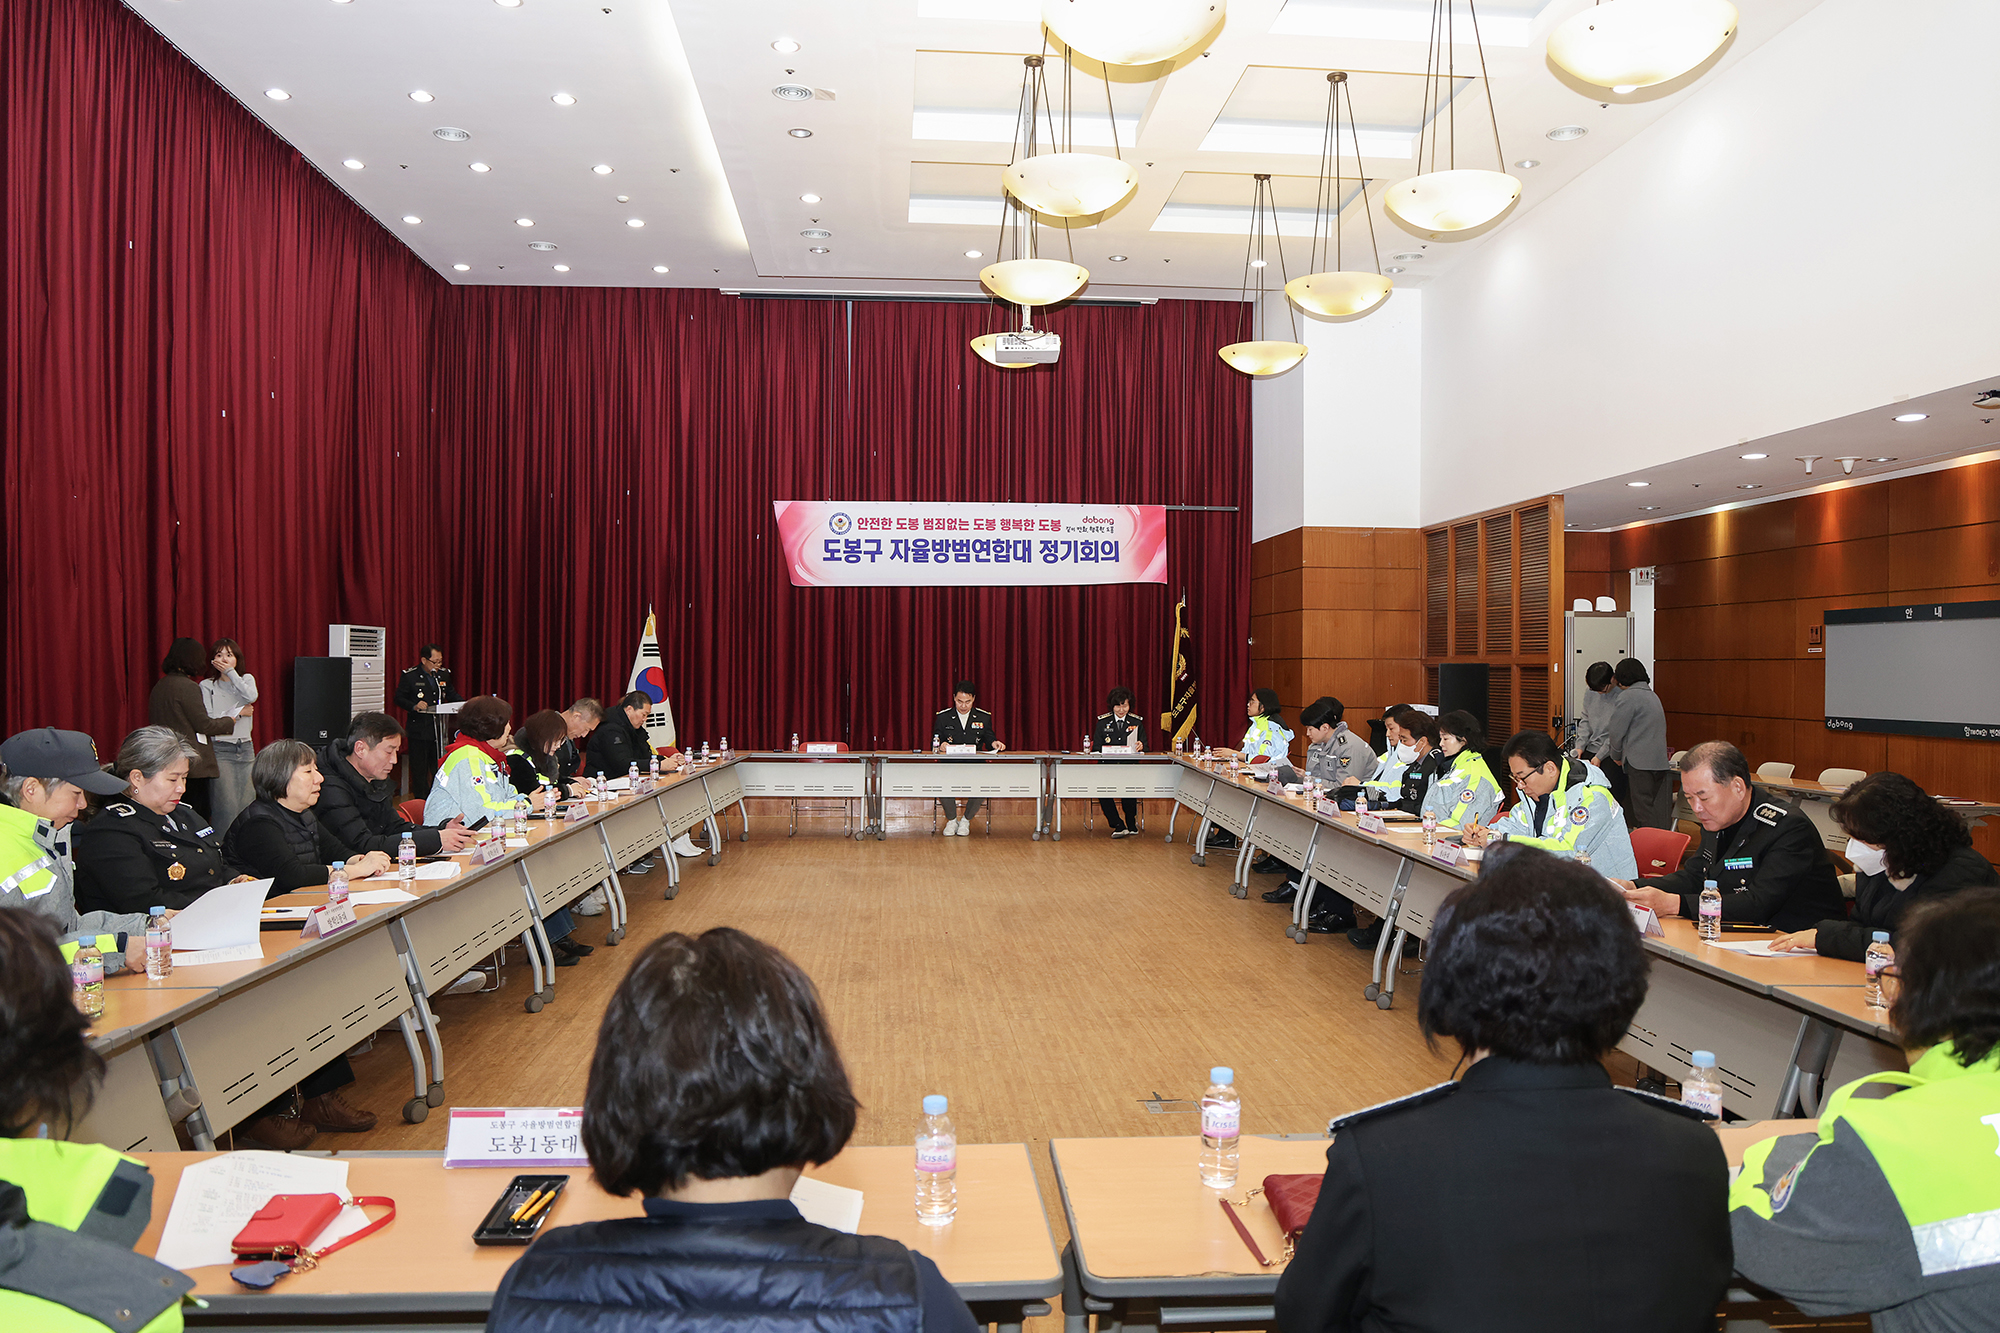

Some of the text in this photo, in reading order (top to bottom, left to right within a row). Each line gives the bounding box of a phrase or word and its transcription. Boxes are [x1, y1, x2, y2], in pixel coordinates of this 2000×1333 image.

[857, 517, 893, 531] 안전한
[896, 517, 920, 531] 도봉
[923, 517, 970, 532] 범죄없는
[973, 518, 997, 532] 도봉
[1000, 518, 1036, 532] 행복한
[1038, 519, 1062, 532] 도봉
[1082, 515, 1115, 526] dobong
[822, 538, 1120, 565] 도봉구 자율방범연합대 정기회의
[1827, 719, 1854, 730] dobong
[489, 1120, 516, 1130] 도봉구
[488, 1134, 578, 1155] 도봉1동대
